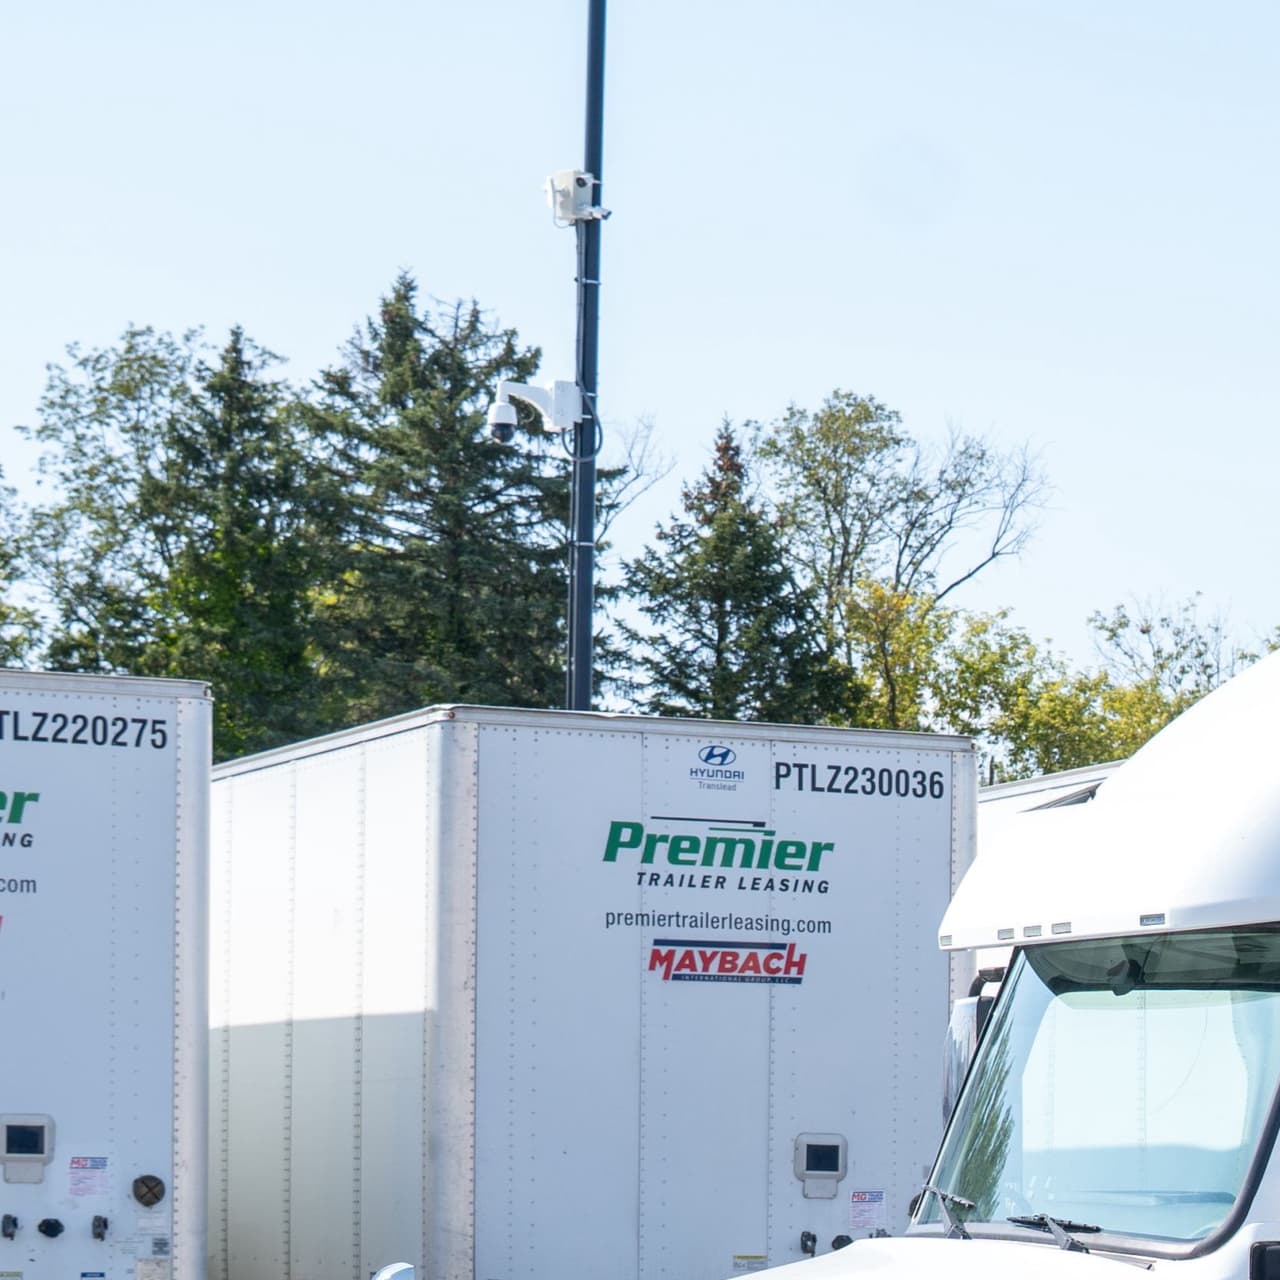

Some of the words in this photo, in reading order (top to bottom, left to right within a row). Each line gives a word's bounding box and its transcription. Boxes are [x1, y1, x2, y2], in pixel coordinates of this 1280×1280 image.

[689, 767, 745, 780] HYUNDAI
[697, 780, 737, 791] Translead
[774, 761, 945, 799] PTLZ230036
[602, 820, 835, 872] Premier
[636, 872, 726, 889] TRAILER
[737, 876, 830, 894] LEASING
[605, 909, 832, 935] premiertrailerleasing.com
[648, 942, 808, 981] MAYBACH
